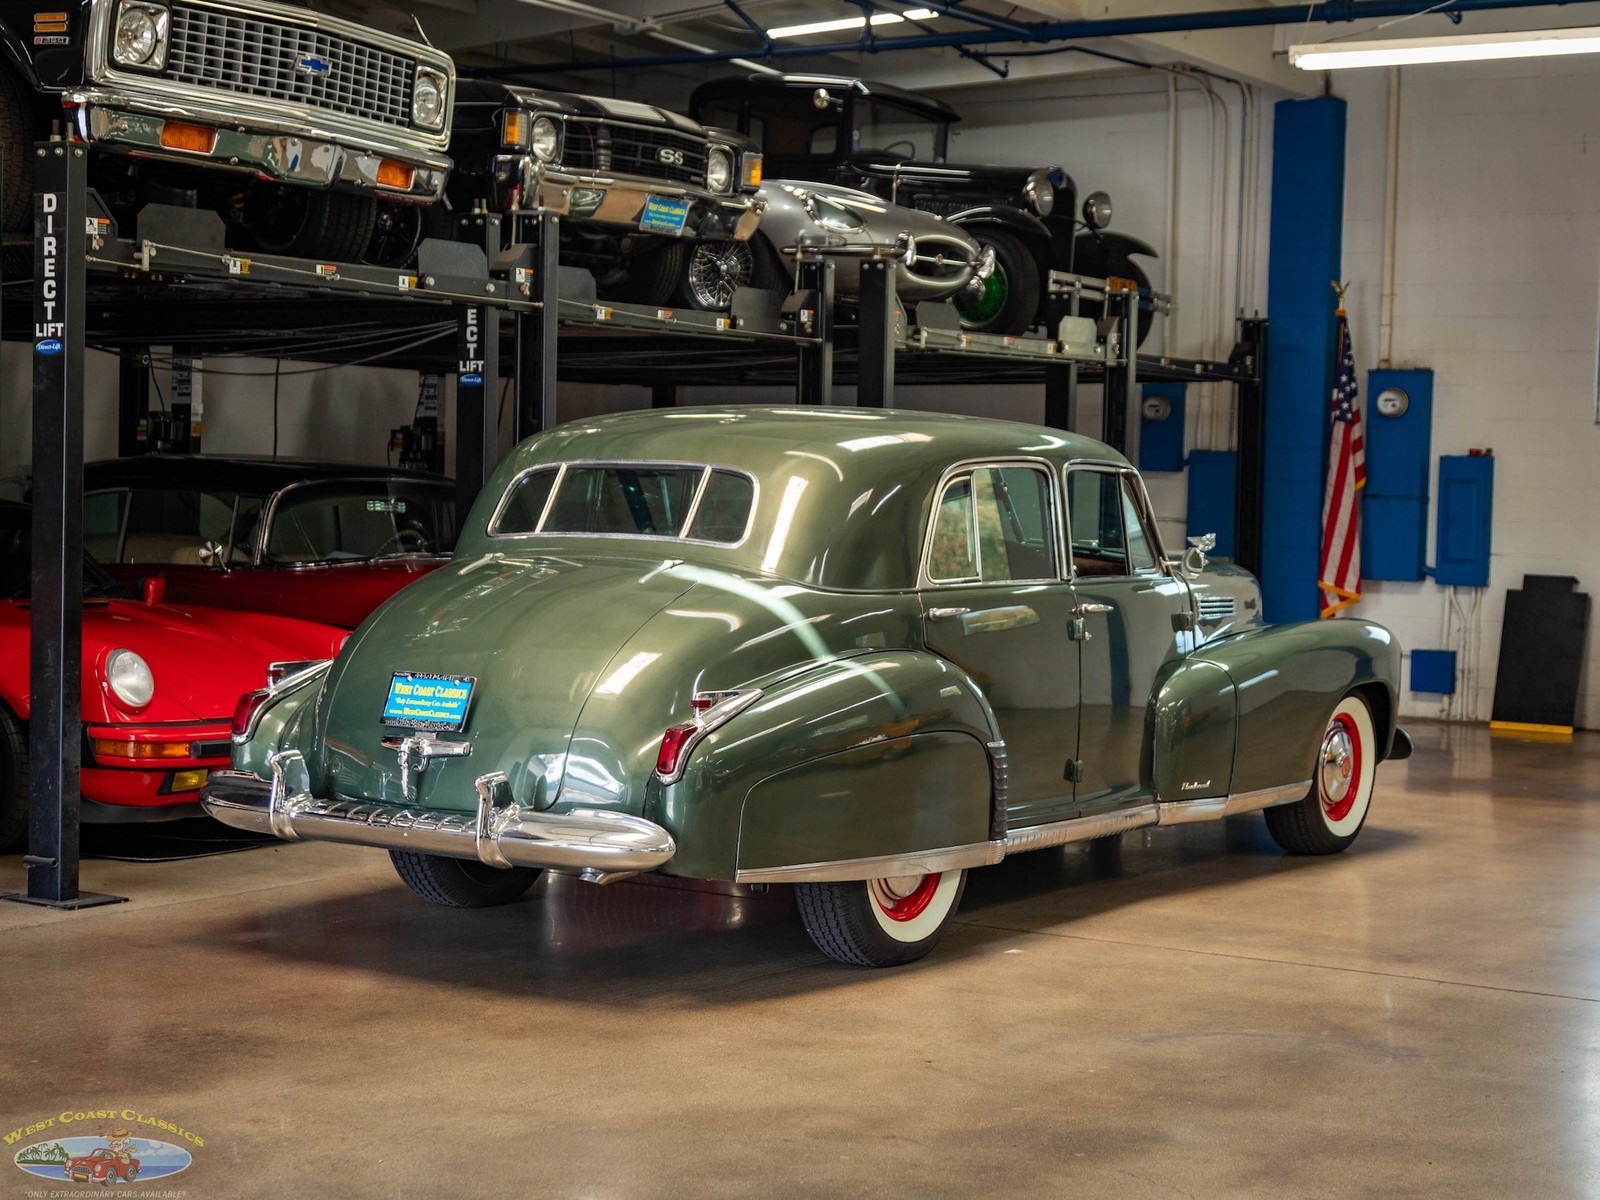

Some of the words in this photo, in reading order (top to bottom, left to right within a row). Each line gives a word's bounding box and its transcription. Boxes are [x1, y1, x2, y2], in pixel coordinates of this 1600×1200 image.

[660, 149, 684, 165] SS
[43, 193, 57, 320] DIRECT
[36, 323, 64, 337] LIFT
[466, 309, 478, 359] ECT
[459, 360, 485, 372] LIFT
